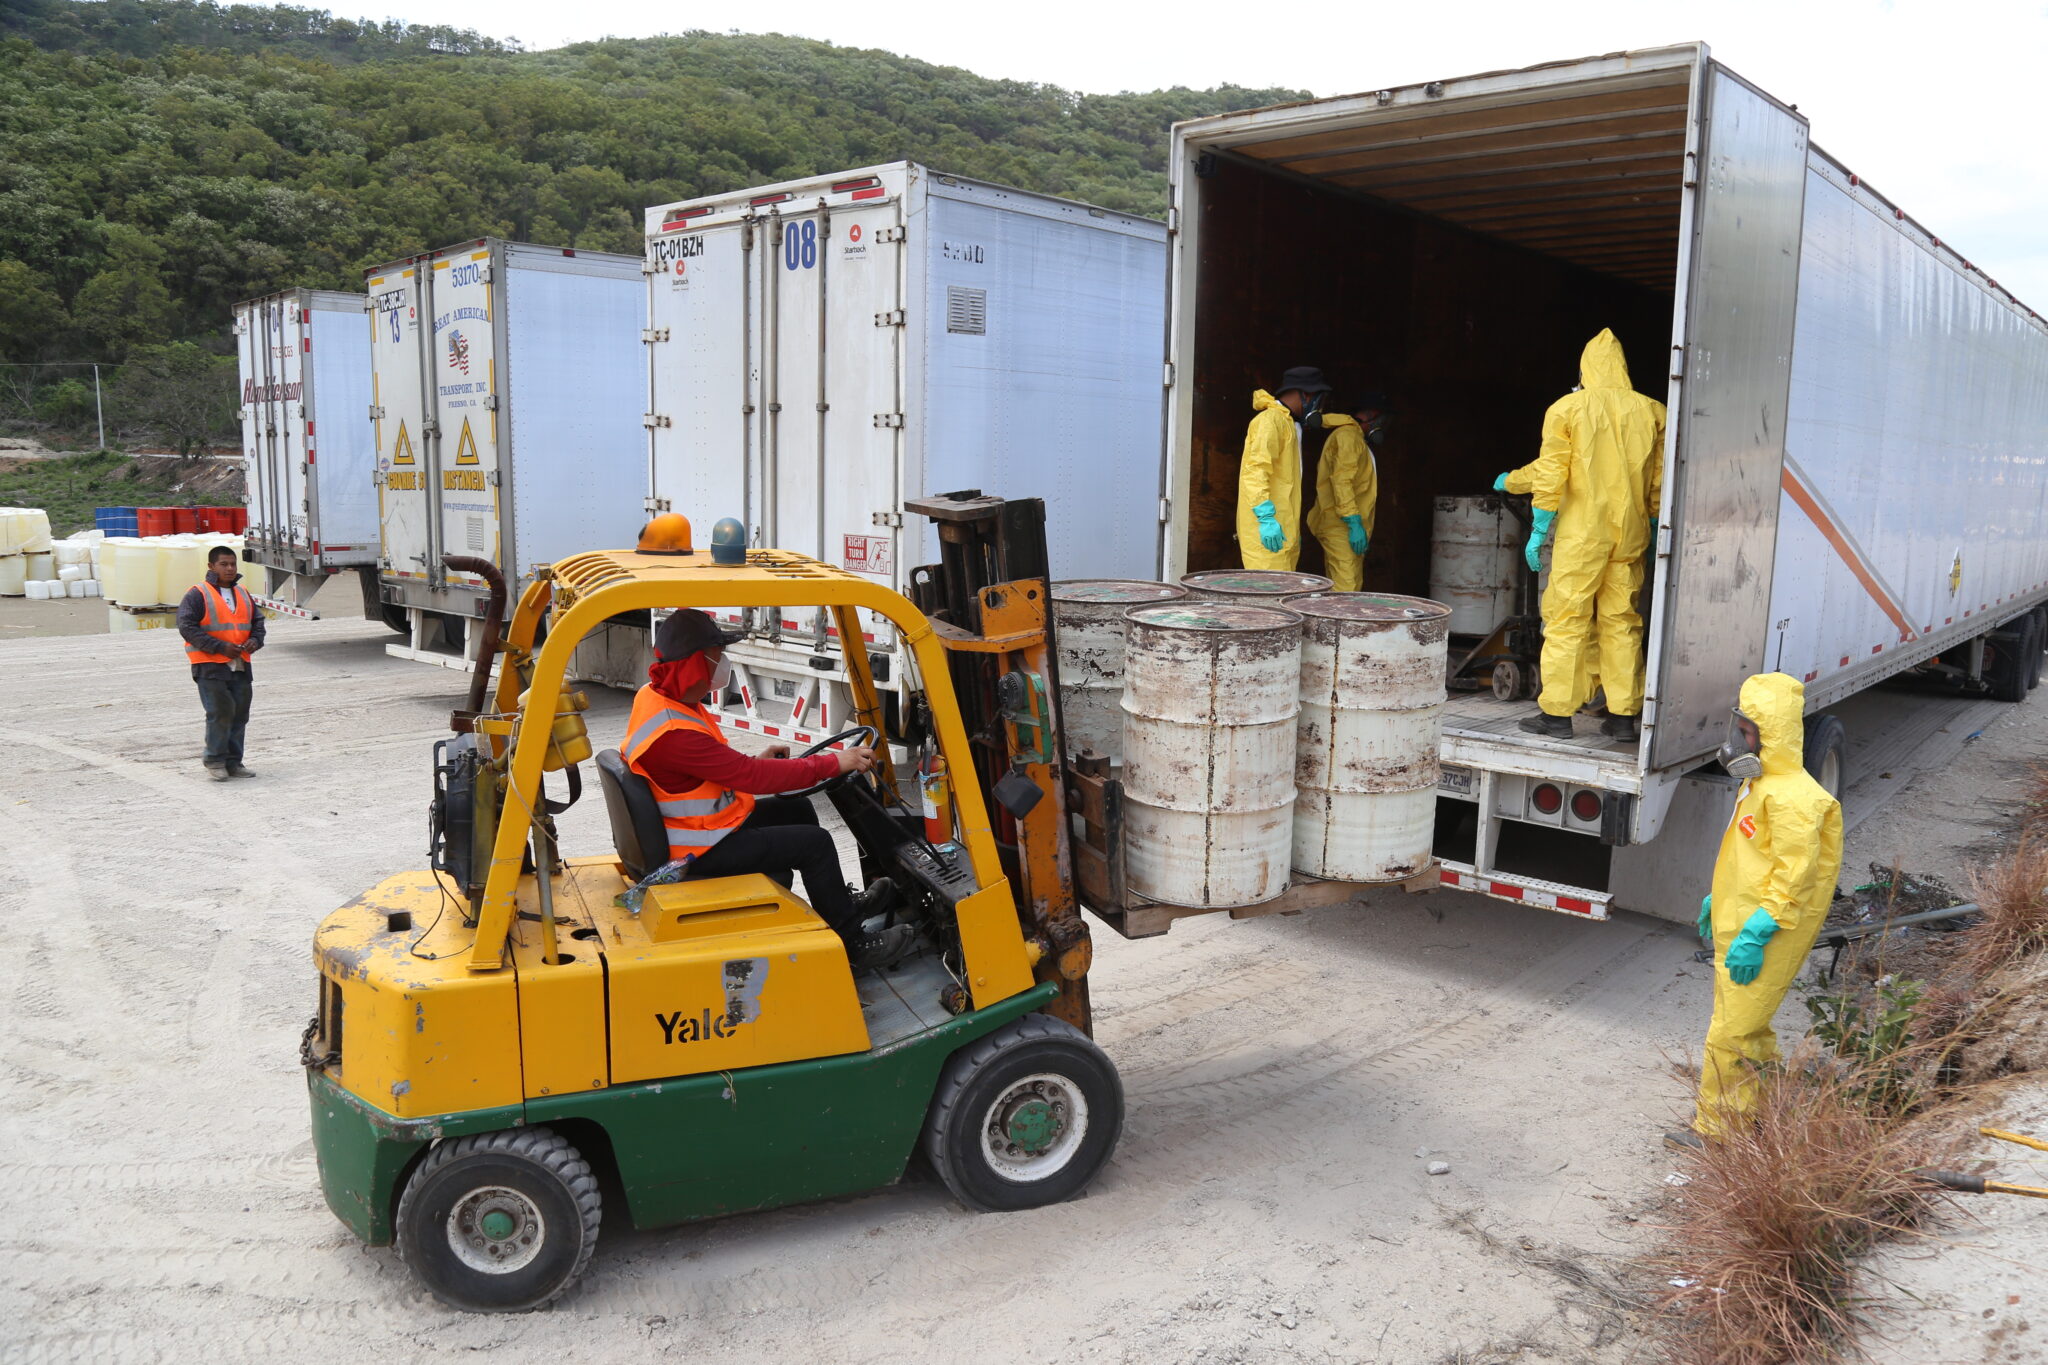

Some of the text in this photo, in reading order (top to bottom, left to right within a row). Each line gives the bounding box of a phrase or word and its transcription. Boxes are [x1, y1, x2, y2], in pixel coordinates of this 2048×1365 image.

[653, 235, 704, 261] TC-01BZH
[785, 219, 816, 271] 08
[451, 263, 480, 288] 53170
[271, 306, 279, 333] 0
[389, 308, 401, 343] 13
[432, 313, 451, 335] REAT
[443, 470, 486, 491] DISTANCIA
[848, 536, 865, 548] RIGHT
[849, 548, 864, 559] TURN
[845, 559, 867, 571] DANGER
